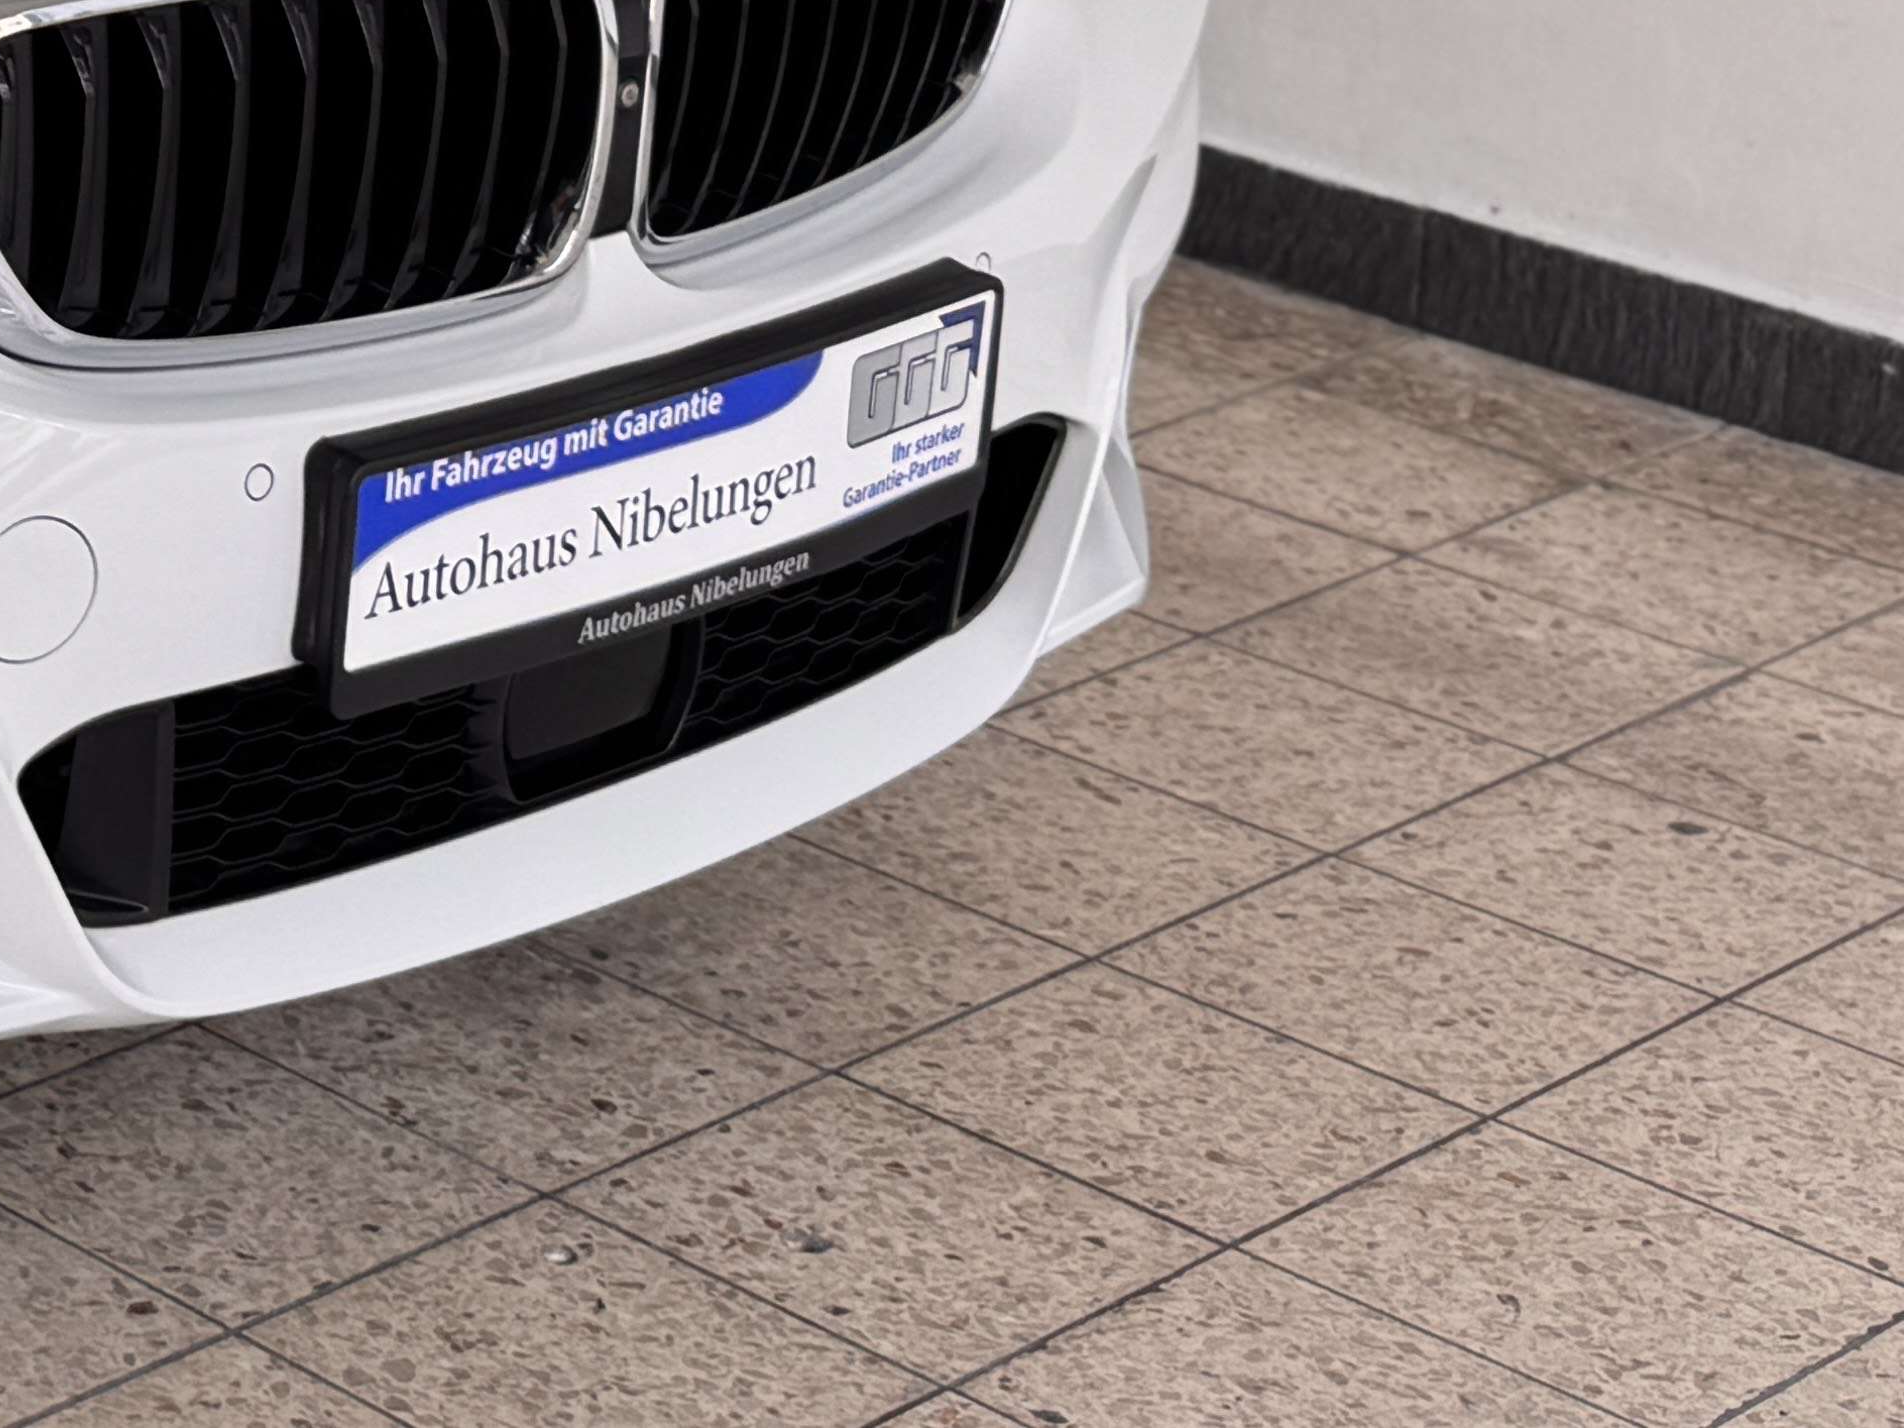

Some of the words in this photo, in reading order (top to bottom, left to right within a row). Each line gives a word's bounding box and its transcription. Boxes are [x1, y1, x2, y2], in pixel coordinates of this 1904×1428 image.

[384, 469, 426, 503] Ihr
[431, 435, 559, 491] Fahrzeug
[563, 416, 610, 457] mit
[613, 386, 725, 442] Garantie
[842, 449, 962, 509] Garantie-Partner
[892, 443, 913, 464] Ihr
[914, 423, 965, 451] starker
[364, 531, 579, 620] Autohaus
[589, 454, 817, 559] Nibelungen
[578, 593, 687, 644] Autohaus
[690, 550, 810, 608] Nibelungen
